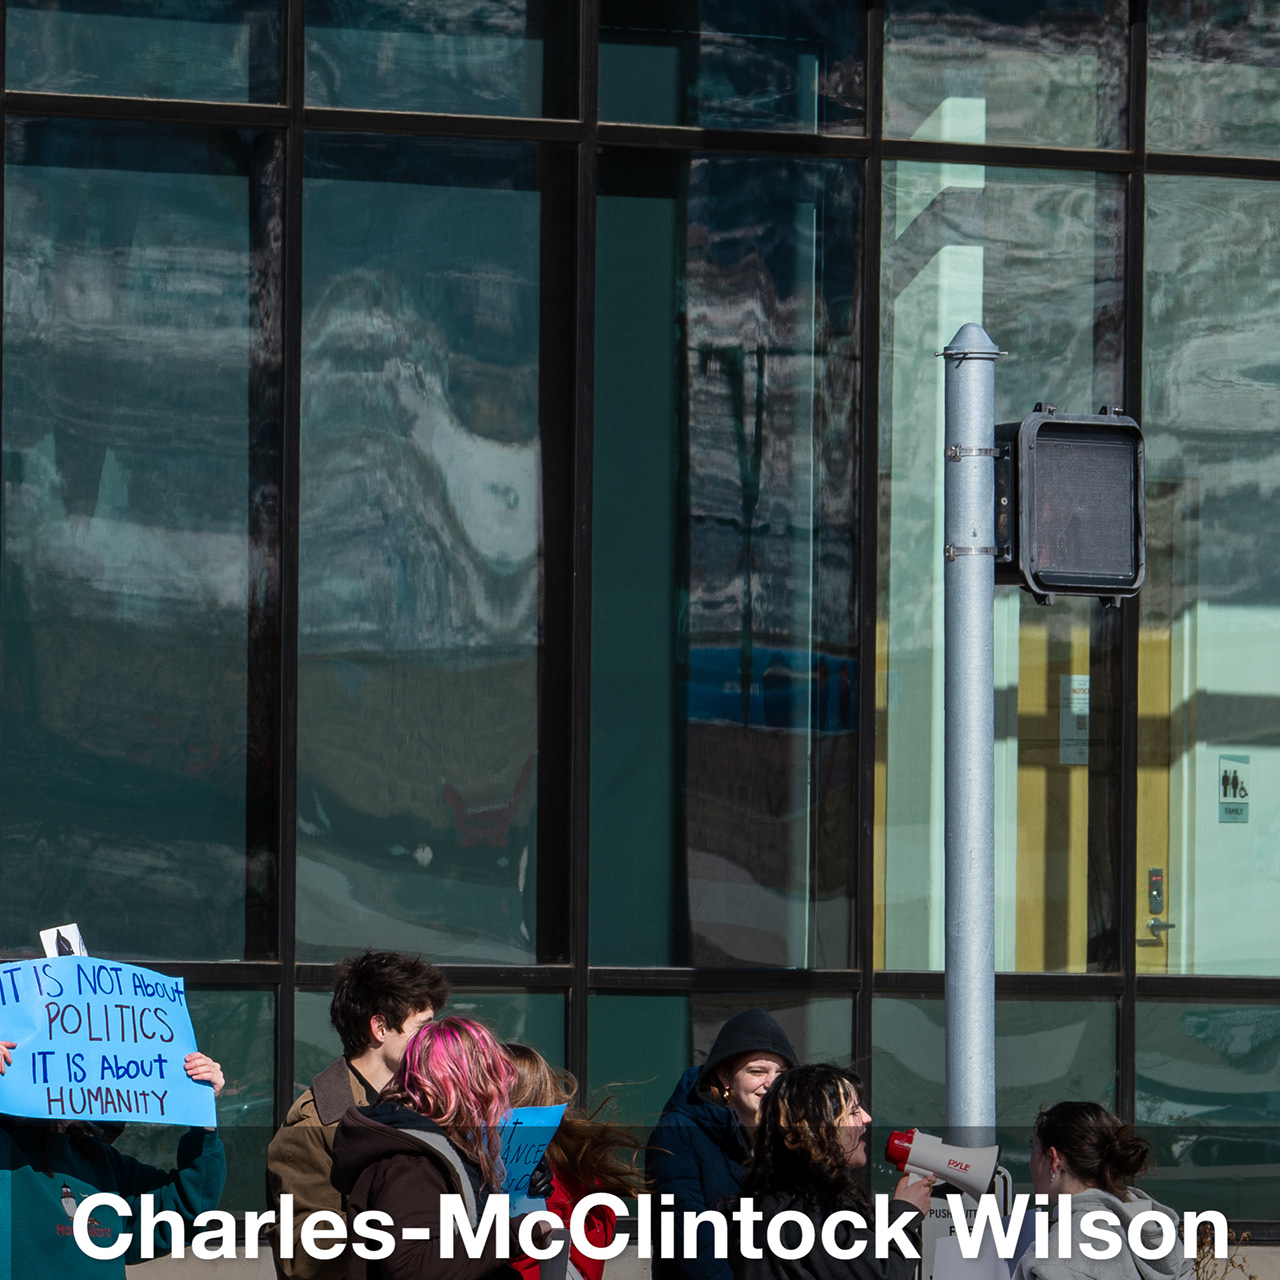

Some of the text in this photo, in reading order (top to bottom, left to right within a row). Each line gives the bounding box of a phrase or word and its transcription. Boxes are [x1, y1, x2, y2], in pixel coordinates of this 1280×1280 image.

[1224, 806, 1245, 816] FAMILY
[33, 963, 64, 998] IS
[77, 963, 123, 996] NOT
[45, 1001, 174, 1043] POLITICS
[31, 1051, 55, 1084] IT
[66, 1052, 87, 1083] IS
[46, 1085, 168, 1116] HUMANITY
